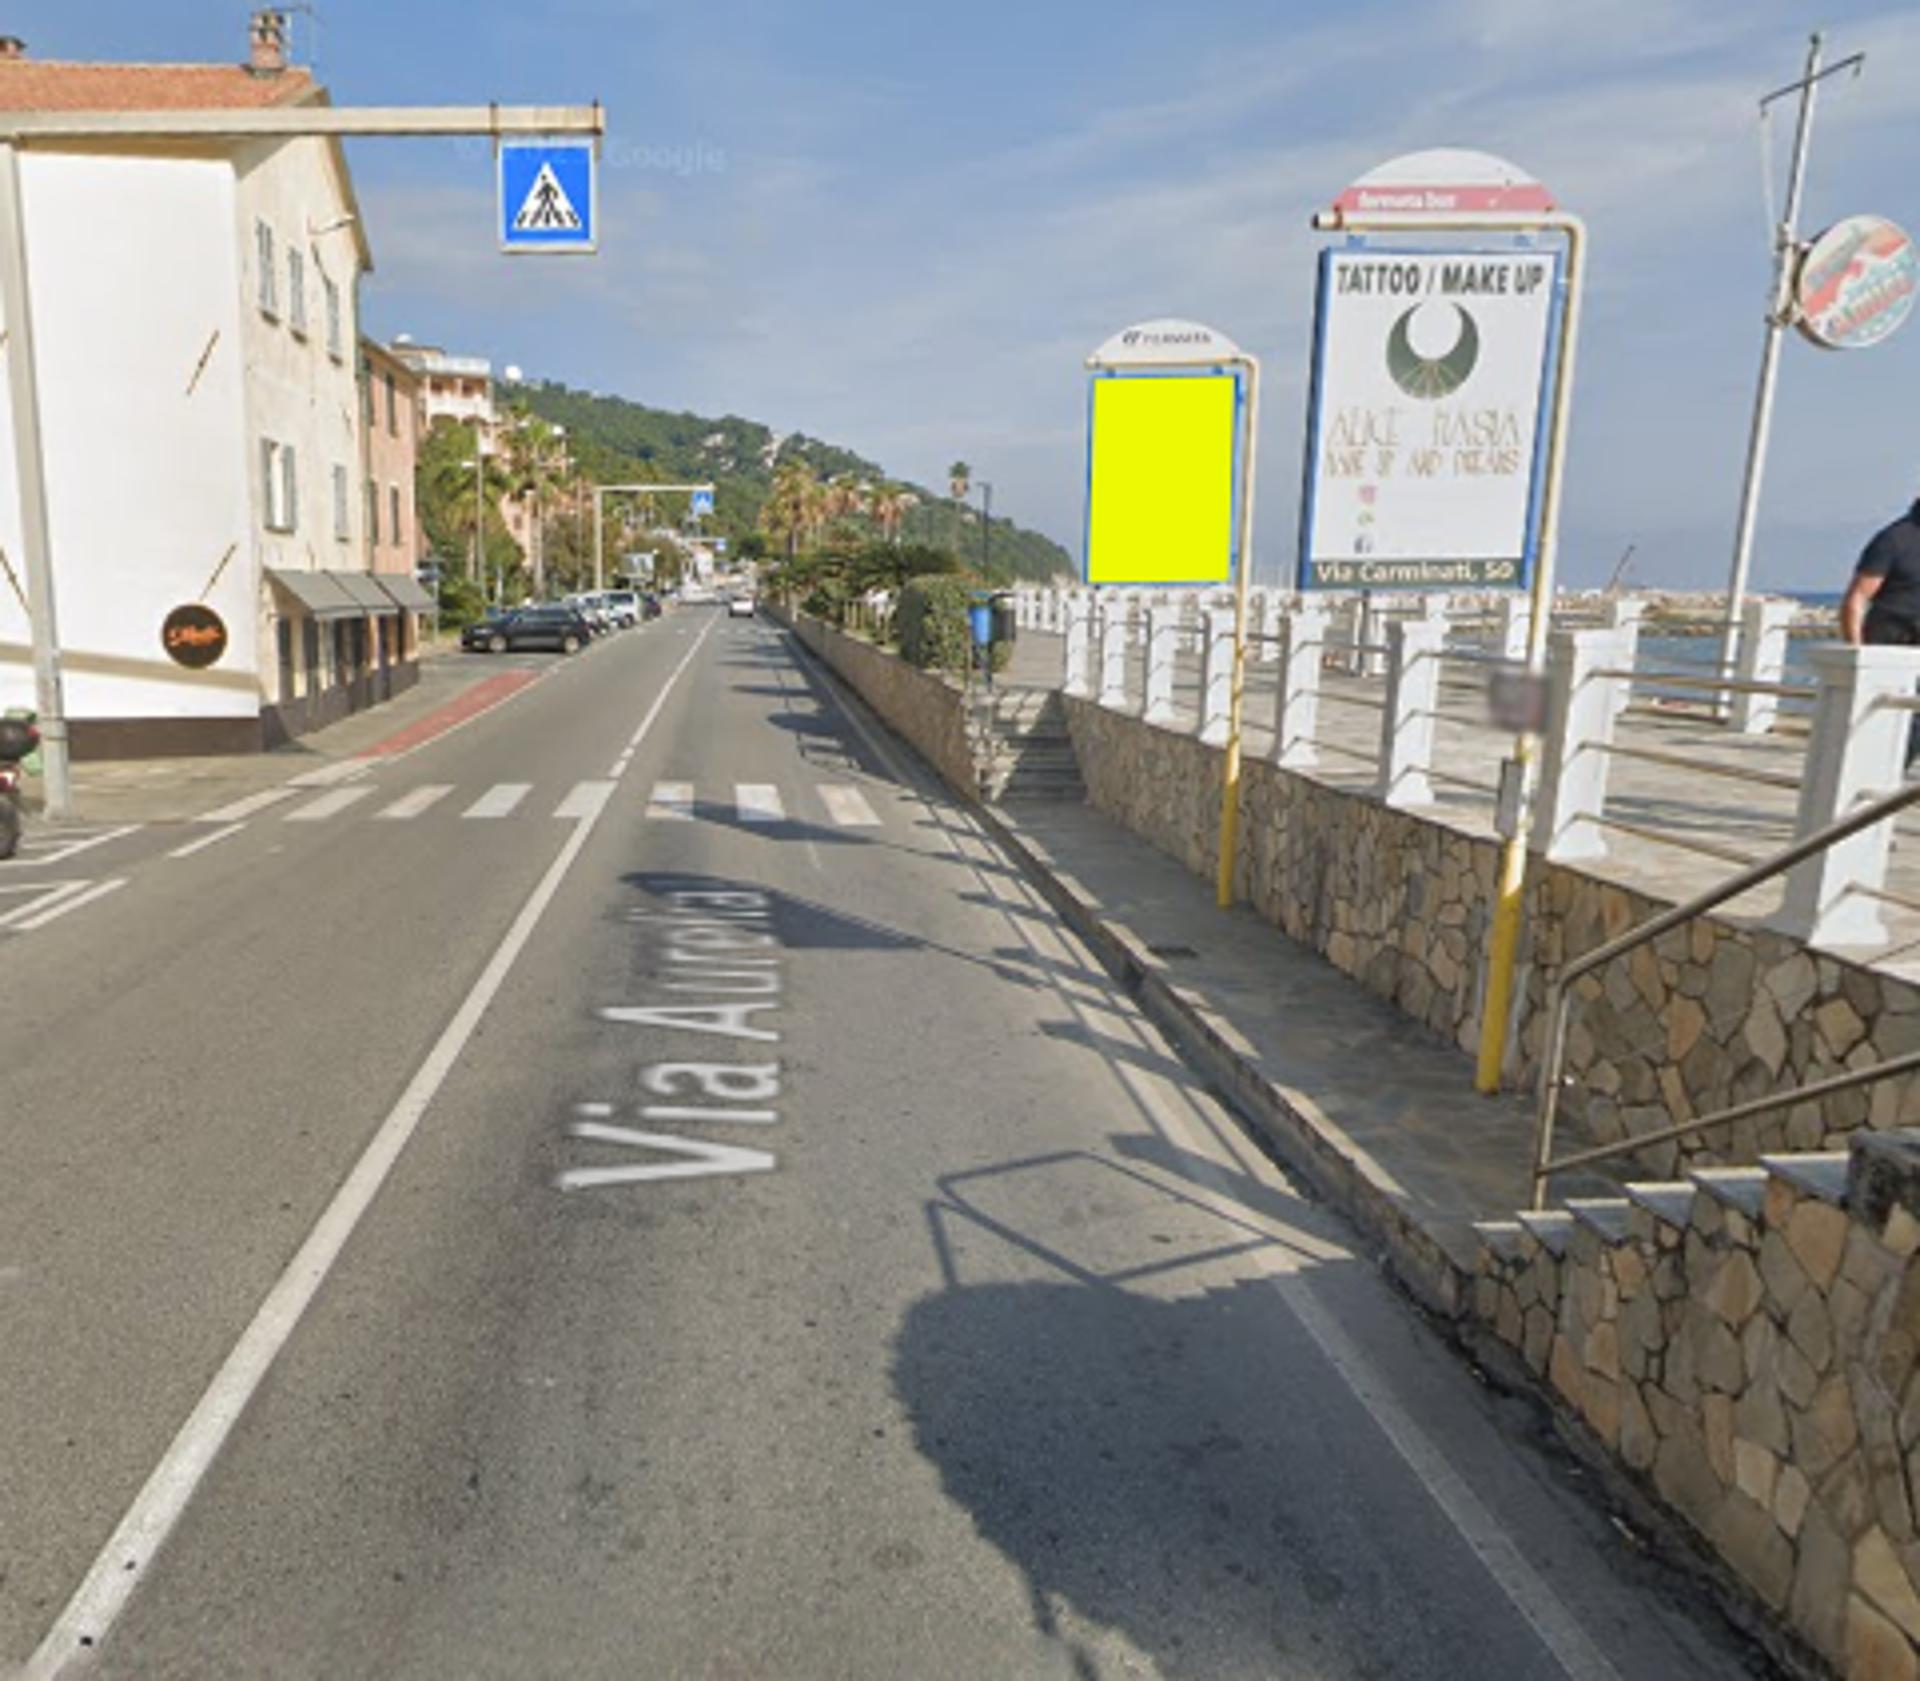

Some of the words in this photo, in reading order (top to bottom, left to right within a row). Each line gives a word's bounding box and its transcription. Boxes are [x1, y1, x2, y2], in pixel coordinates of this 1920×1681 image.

[1336, 263, 1421, 294] TATTOO
[1424, 264, 1435, 294] /
[1440, 263, 1508, 295] MAKE
[1513, 264, 1544, 294] UP
[1317, 562, 1351, 583] Via
[1358, 560, 1479, 583] Carminati,
[1484, 560, 1515, 581] 50
